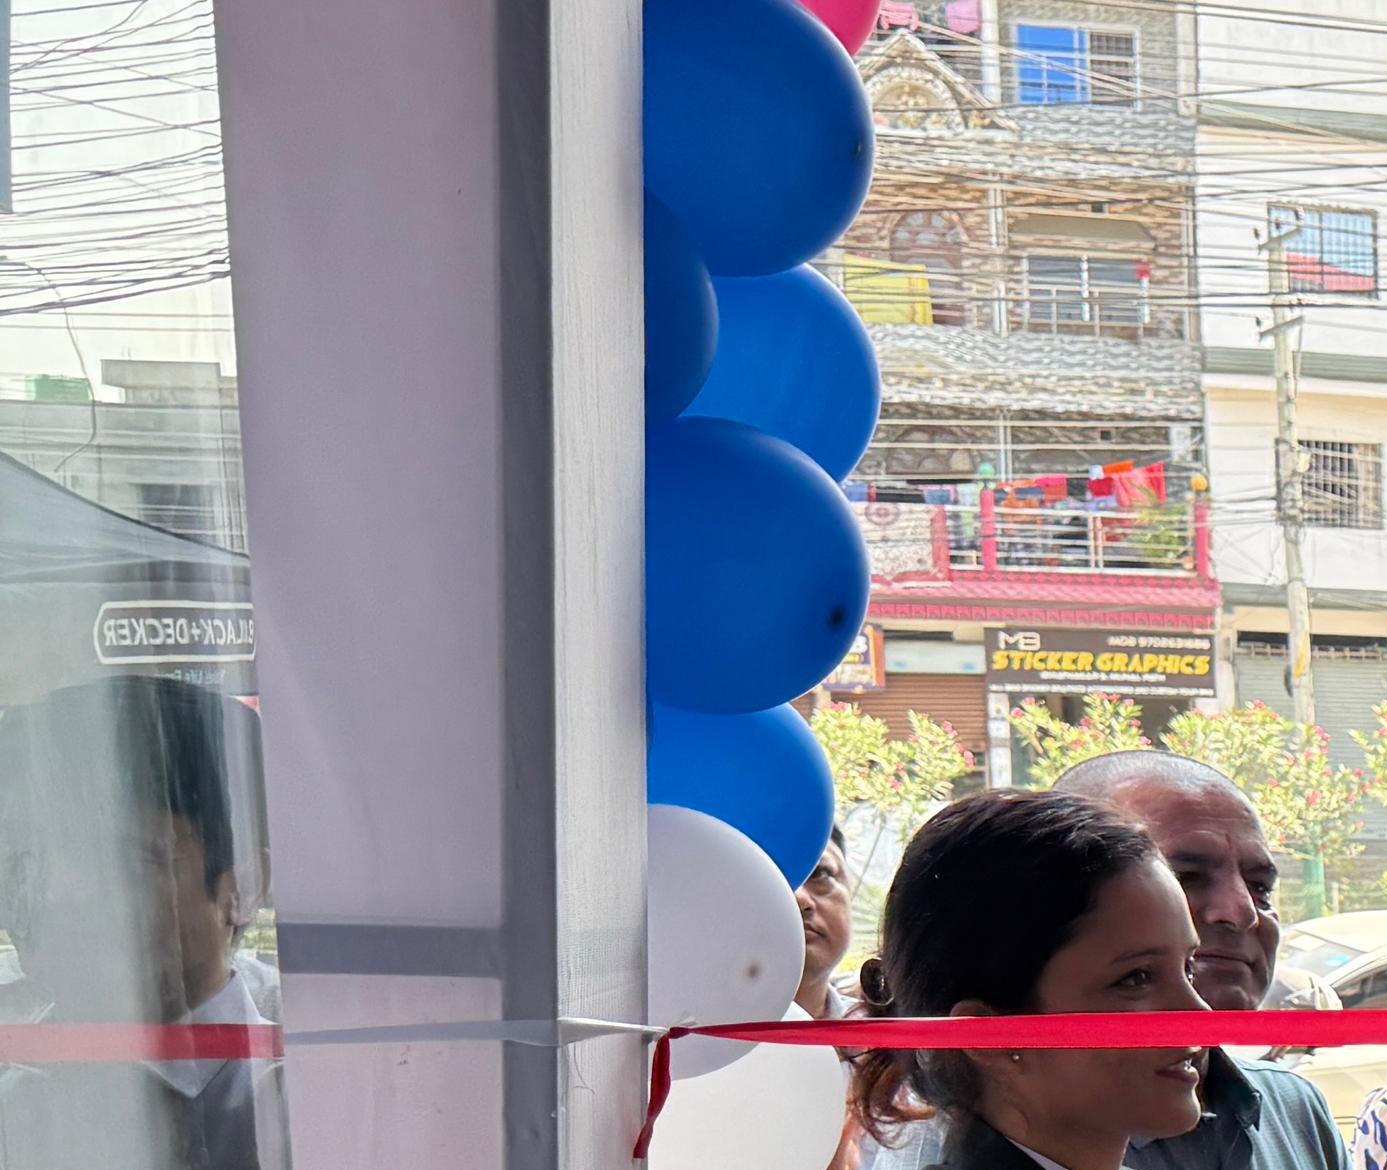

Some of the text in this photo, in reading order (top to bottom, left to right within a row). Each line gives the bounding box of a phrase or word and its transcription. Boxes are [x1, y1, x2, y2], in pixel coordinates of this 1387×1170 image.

[998, 631, 1041, 651] MB
[991, 651, 1211, 675] STICKER GRAPHICS
